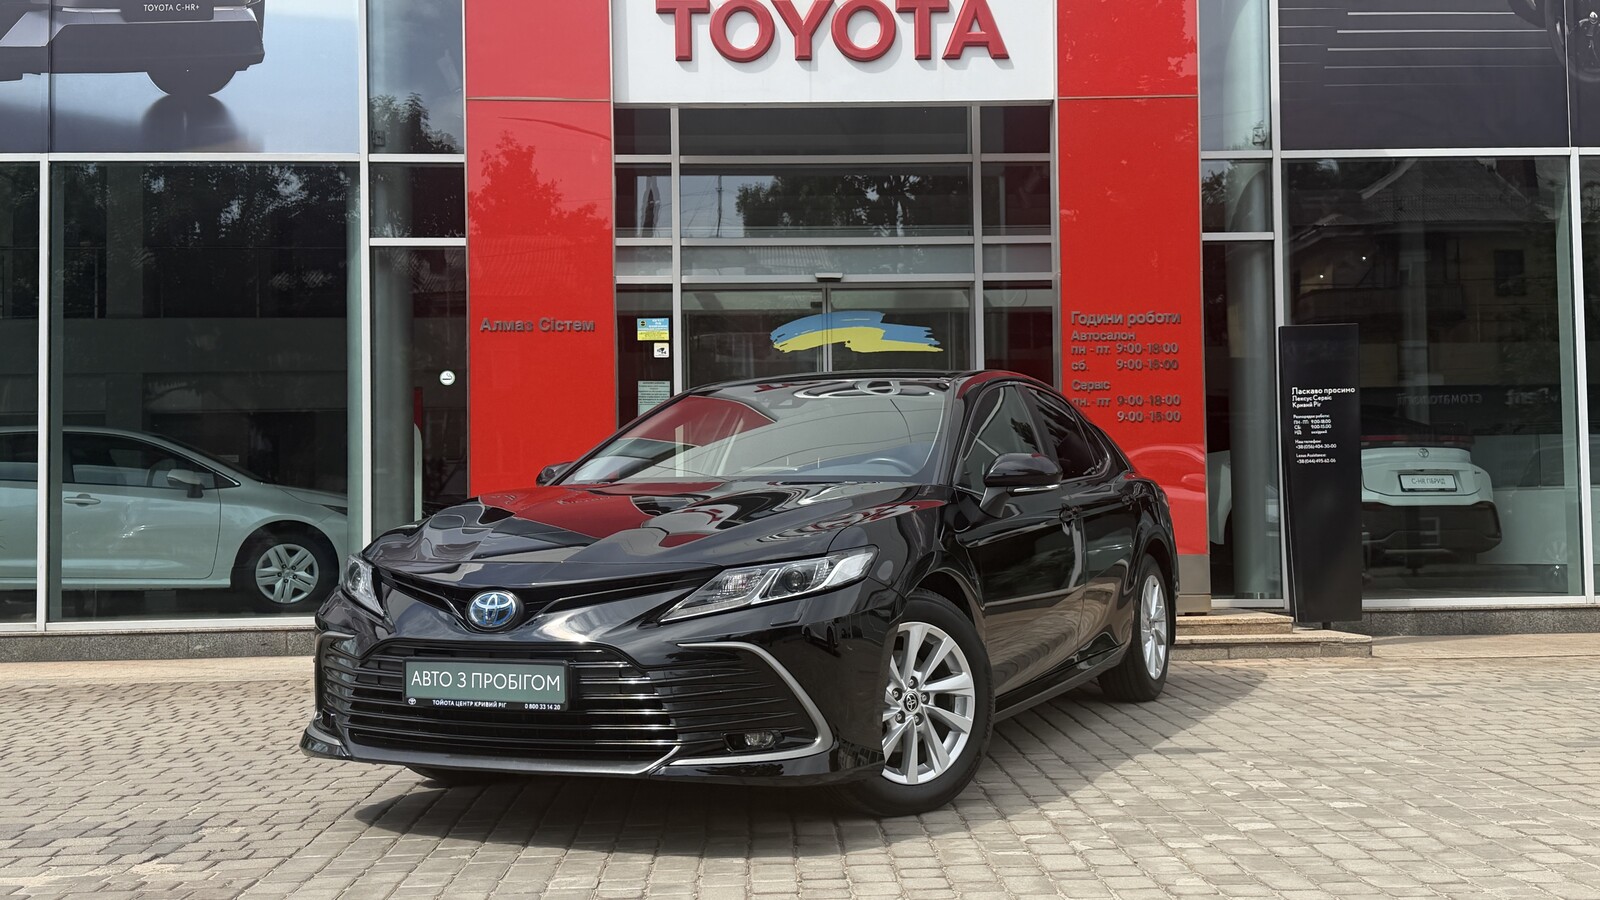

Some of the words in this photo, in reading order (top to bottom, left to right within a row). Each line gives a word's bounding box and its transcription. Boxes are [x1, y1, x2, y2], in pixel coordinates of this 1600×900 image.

[143, 4, 174, 12] TOYOTA
[176, 3, 200, 12] C-HR+
[655, 0, 1010, 63] TOYOTA
[1071, 310, 1123, 327] Години
[1127, 309, 1181, 327] роботи
[480, 317, 534, 332] Алмаз
[539, 316, 595, 332] Сістем
[1071, 329, 1136, 341] Автосалон
[1070, 345, 1086, 354] пн
[1071, 359, 1089, 370] сб.
[1071, 379, 1111, 393] Сервіс
[1292, 387, 1323, 395] Ласкаво
[1313, 394, 1332, 402] Сервіс
[411, 670, 453, 688] АВТО
[471, 672, 560, 692] ПРОБІГОМ
[432, 699, 455, 707] ТОЙОТА
[455, 700, 474, 708] ЦЕНТР
[474, 700, 498, 708] КРИВИЙ
